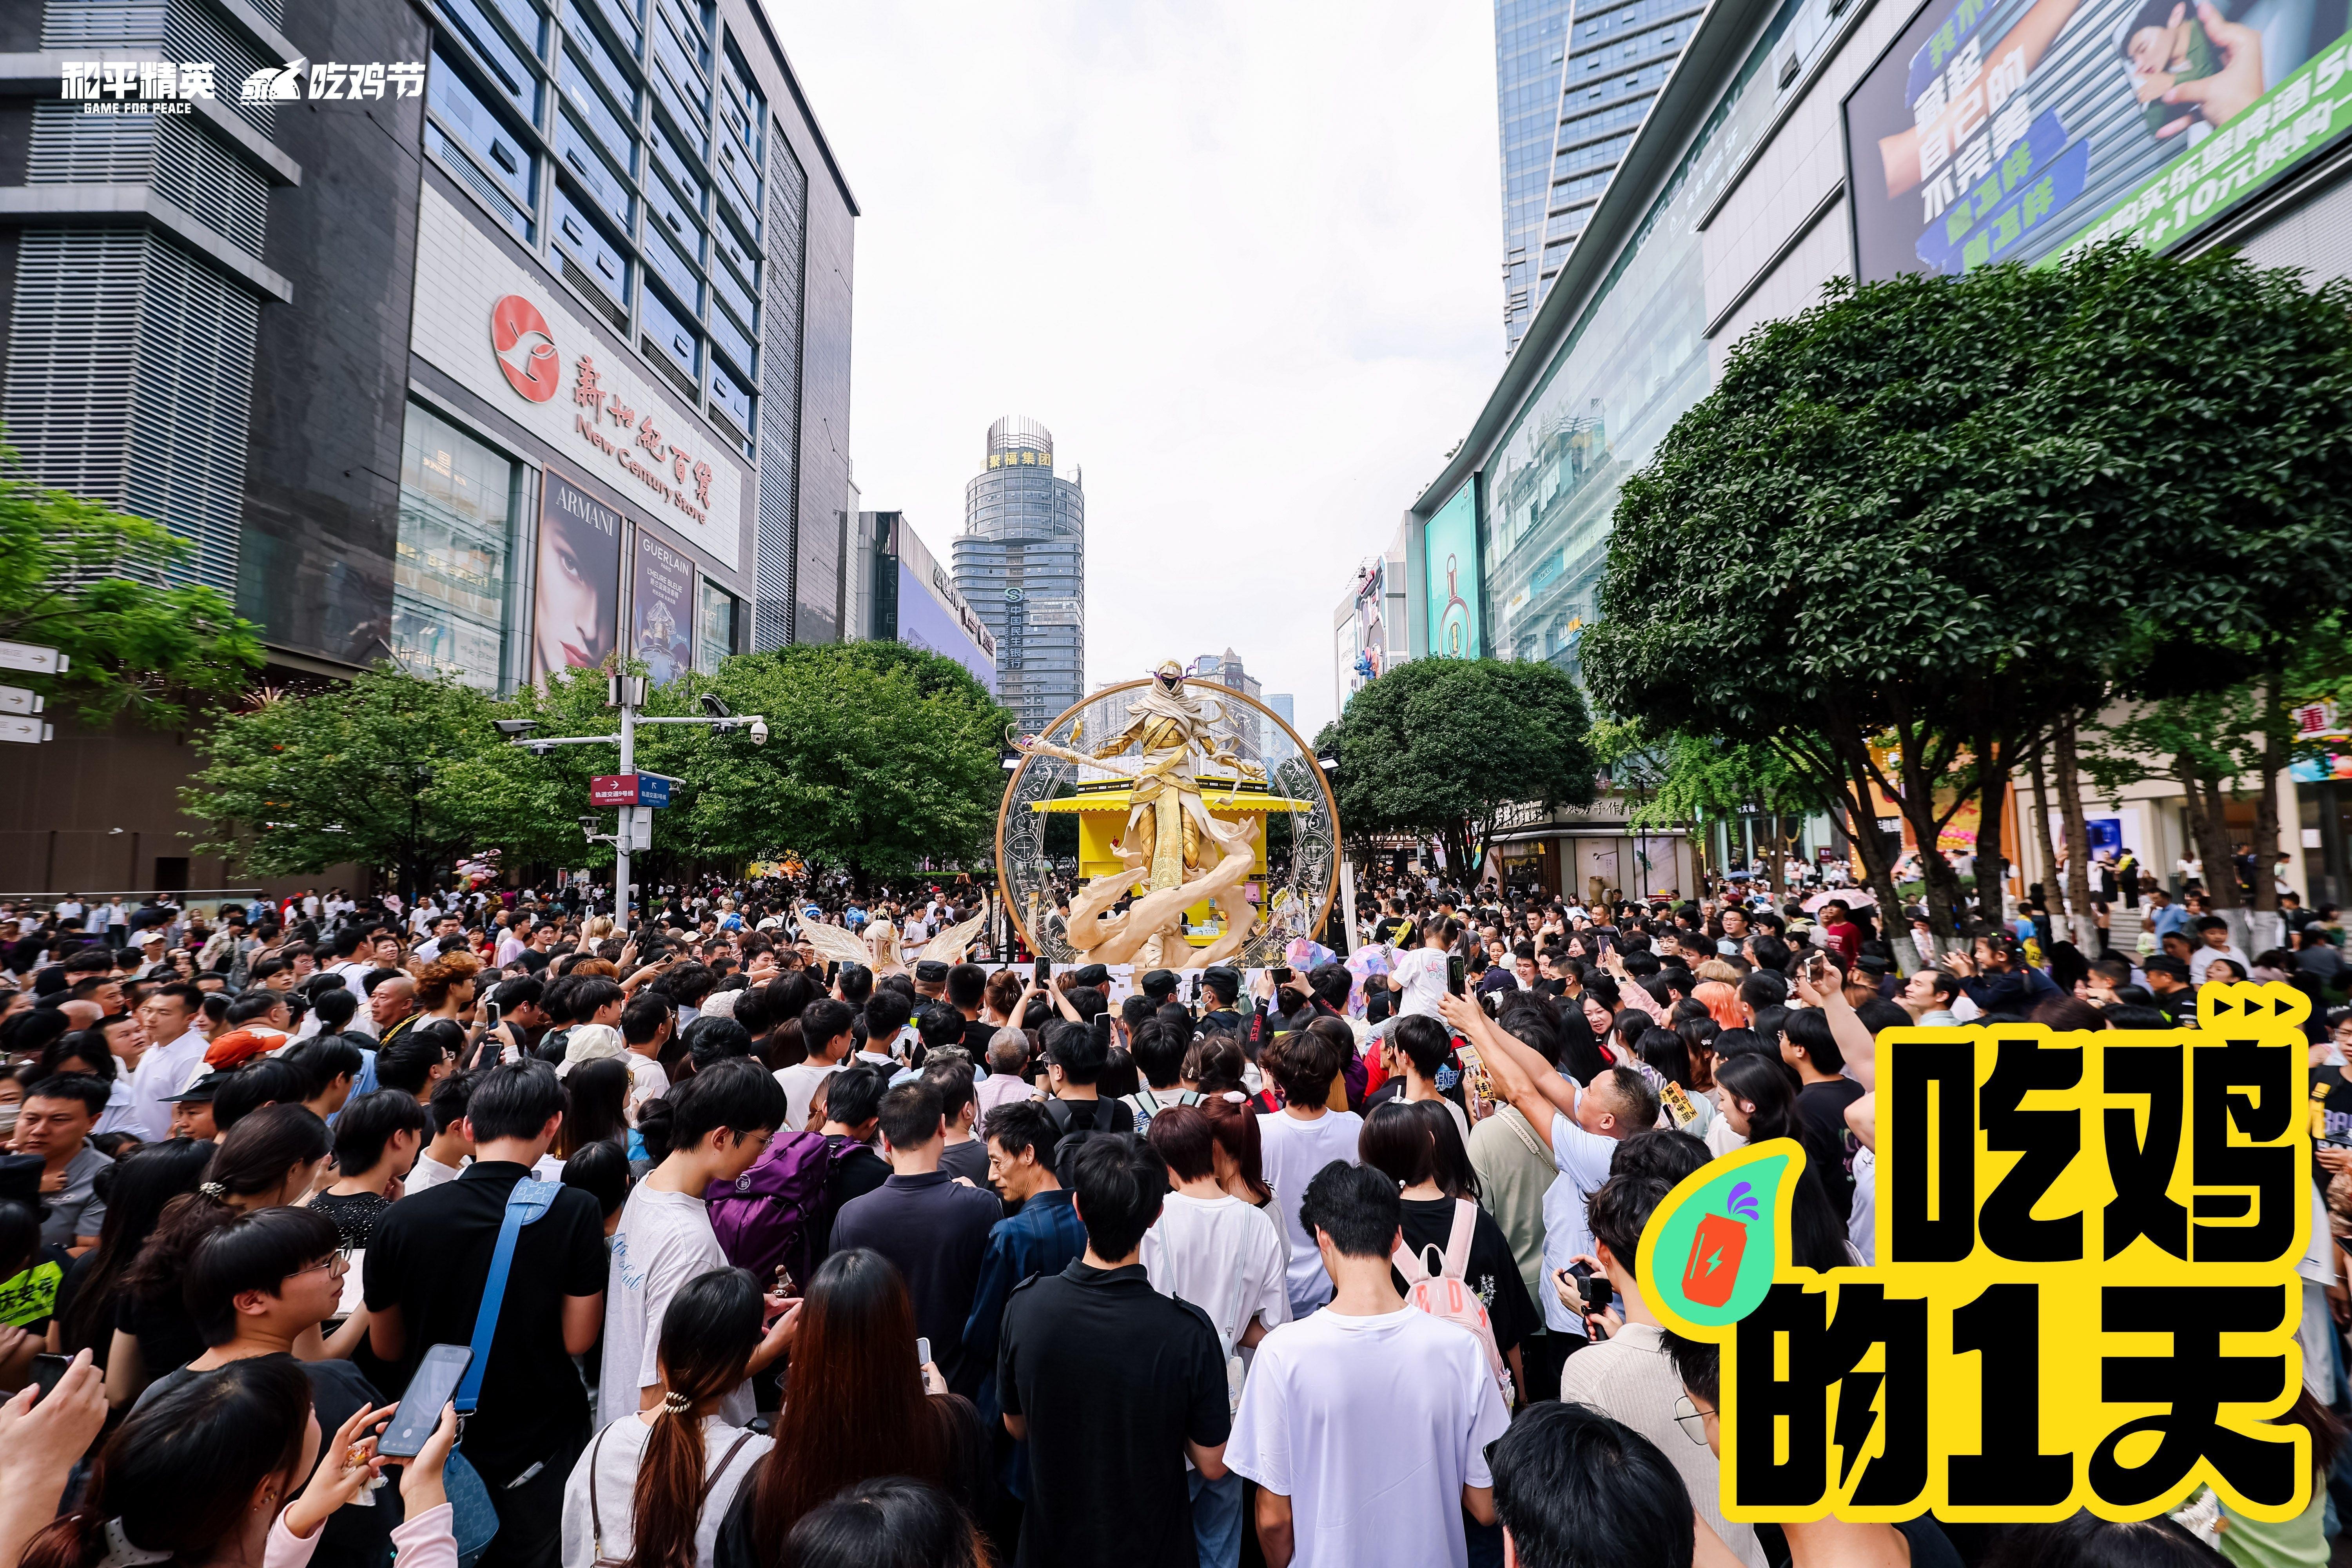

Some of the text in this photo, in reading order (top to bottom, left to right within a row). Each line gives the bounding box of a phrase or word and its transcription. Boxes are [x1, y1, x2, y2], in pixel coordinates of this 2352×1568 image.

[1919, 44, 2027, 182] 自己的
[1922, 93, 2031, 224] 不完美
[576, 414, 707, 525] New Century Store
[989, 451, 1051, 468] 聚福集团
[555, 486, 613, 537] ARMANI
[643, 538, 688, 576] GUERLAIN
[661, 563, 671, 573] PARIS
[647, 567, 682, 593] L'HEURE BLEUE
[1010, 606, 1022, 668] 中国民生银行
[641, 791, 666, 800] 轨道交通3号线
[1438, 1071, 1461, 1085] ENER
[1665, 1087, 1691, 1122] 集章手册
